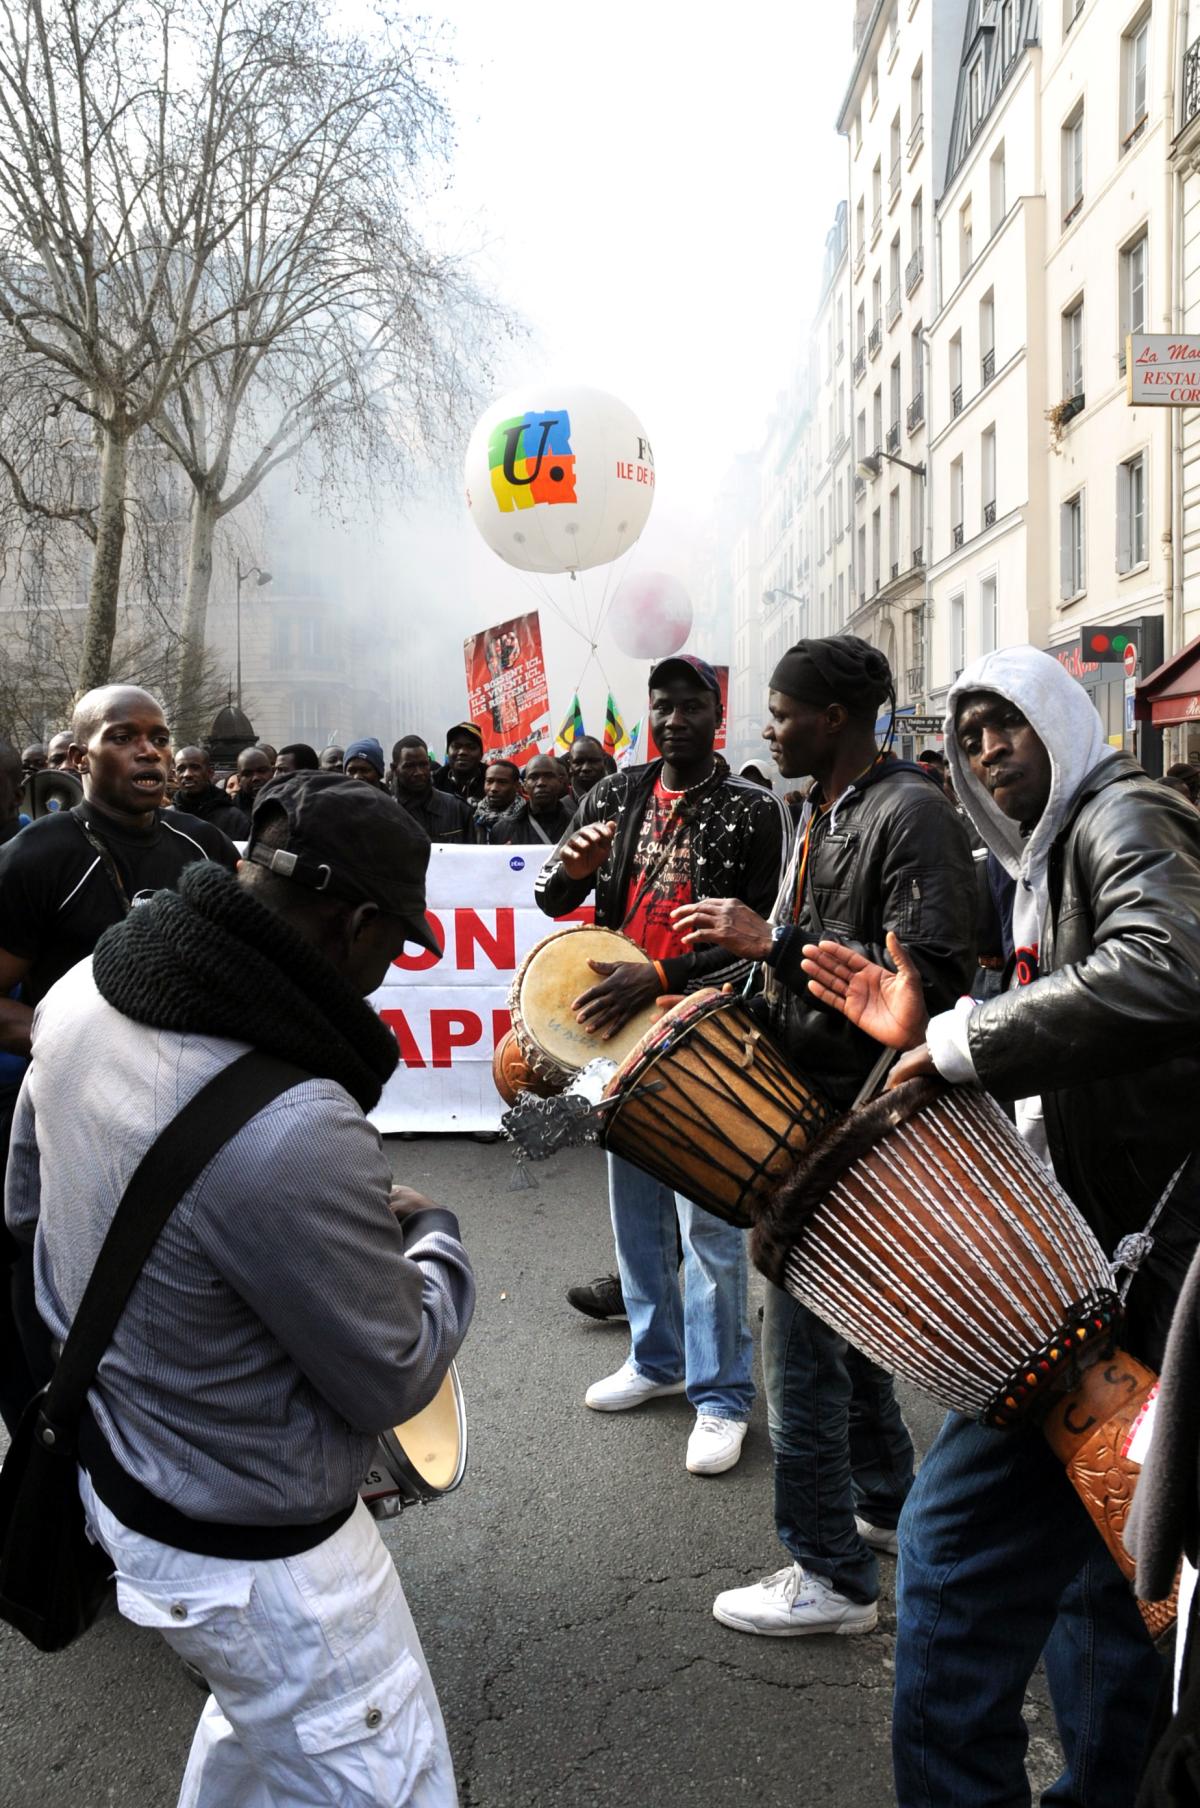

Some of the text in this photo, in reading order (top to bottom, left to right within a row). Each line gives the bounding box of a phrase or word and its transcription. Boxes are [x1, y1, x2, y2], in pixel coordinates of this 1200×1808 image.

[1135, 346, 1159, 363] La
[616, 461, 634, 481] ILE
[636, 465, 648, 484] DE
[471, 694, 486, 708] ILS
[488, 674, 523, 698] VIVENT
[472, 703, 487, 717] ILS
